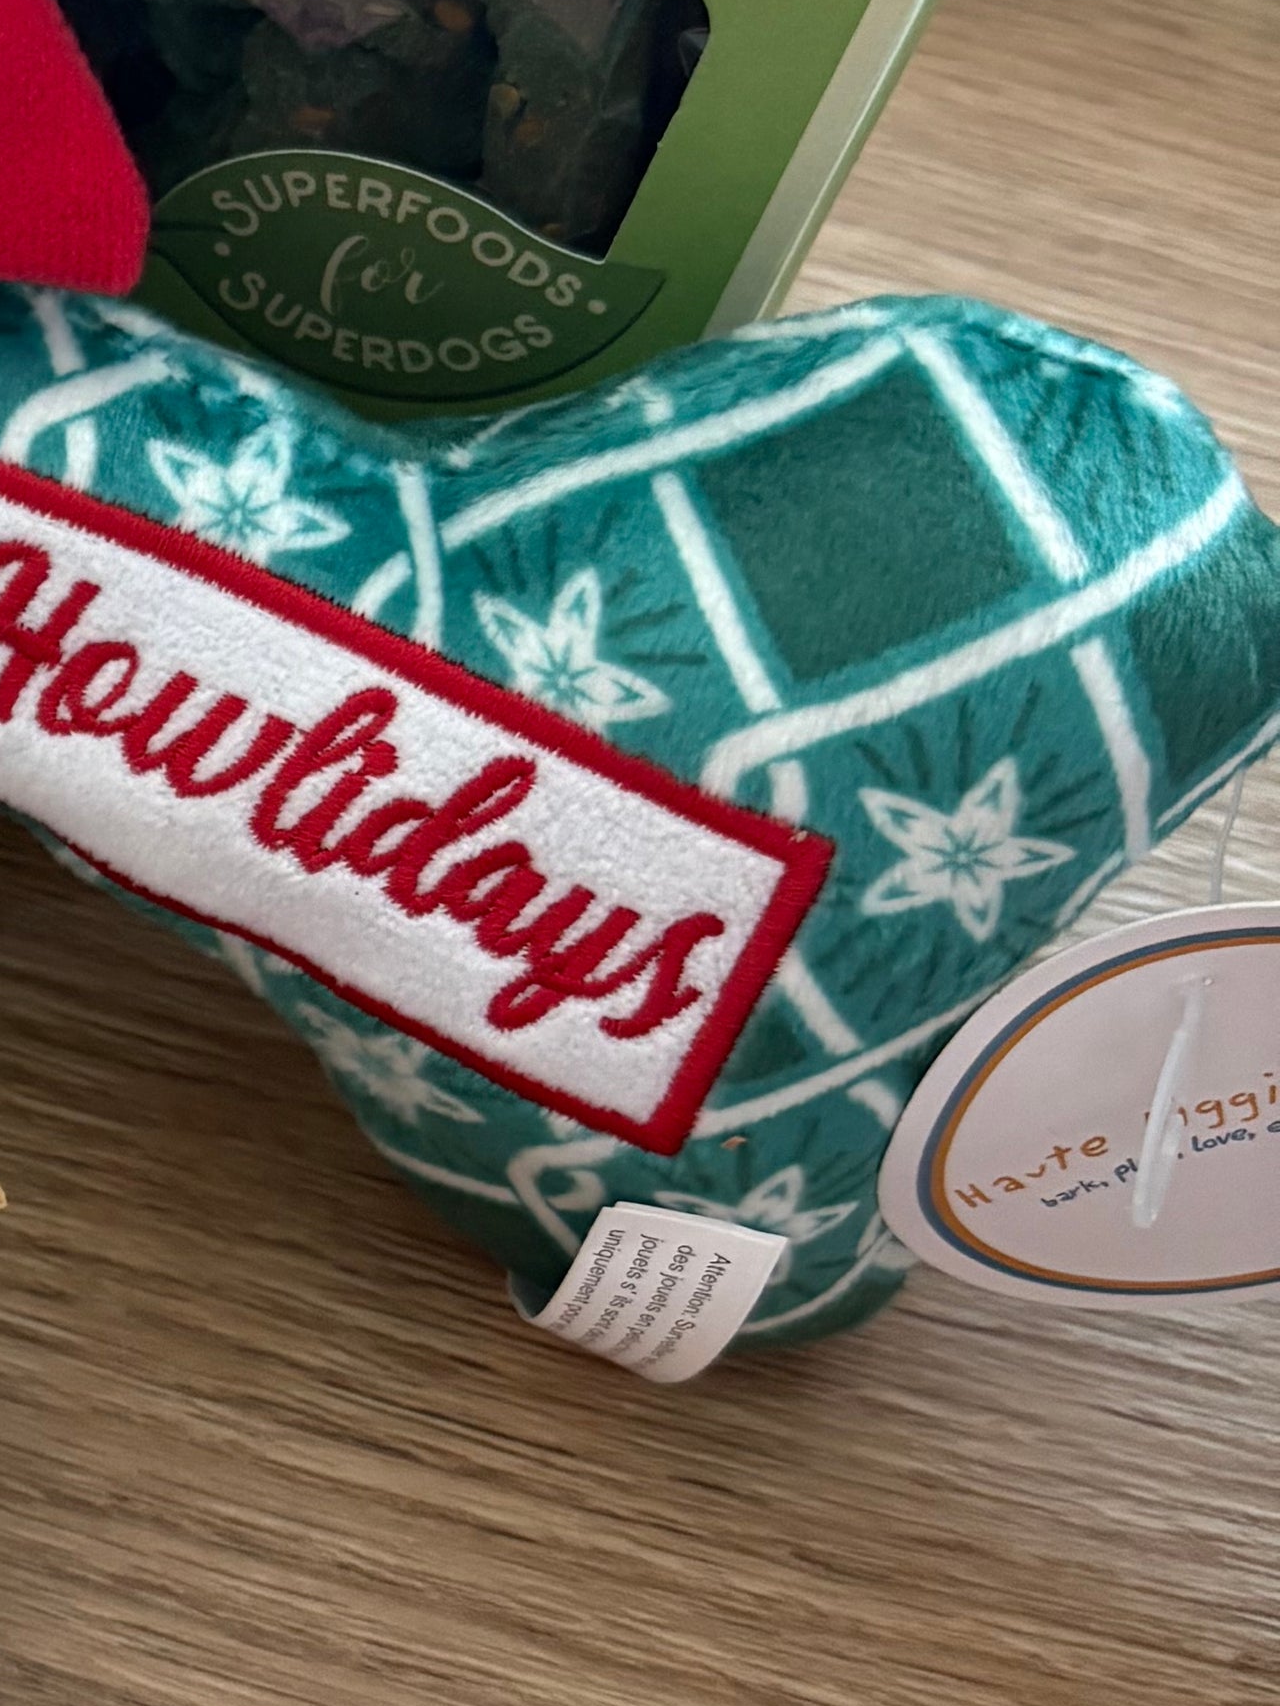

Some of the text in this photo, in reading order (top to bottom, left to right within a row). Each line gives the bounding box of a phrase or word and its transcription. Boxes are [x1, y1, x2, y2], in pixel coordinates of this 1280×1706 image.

[211, 169, 584, 309] SUPERFOODS
[319, 234, 440, 316] for
[219, 272, 555, 373] SUPERDOGS
[954, 1135, 1108, 1208] Haute
[1040, 1178, 1109, 1208] bark,
[1190, 1126, 1257, 1153] love,
[571, 1229, 626, 1305] uniquement
[626, 1233, 664, 1280] jouets
[646, 1271, 683, 1313] jouets
[668, 1245, 696, 1273] des
[681, 1253, 732, 1319] Attention:
